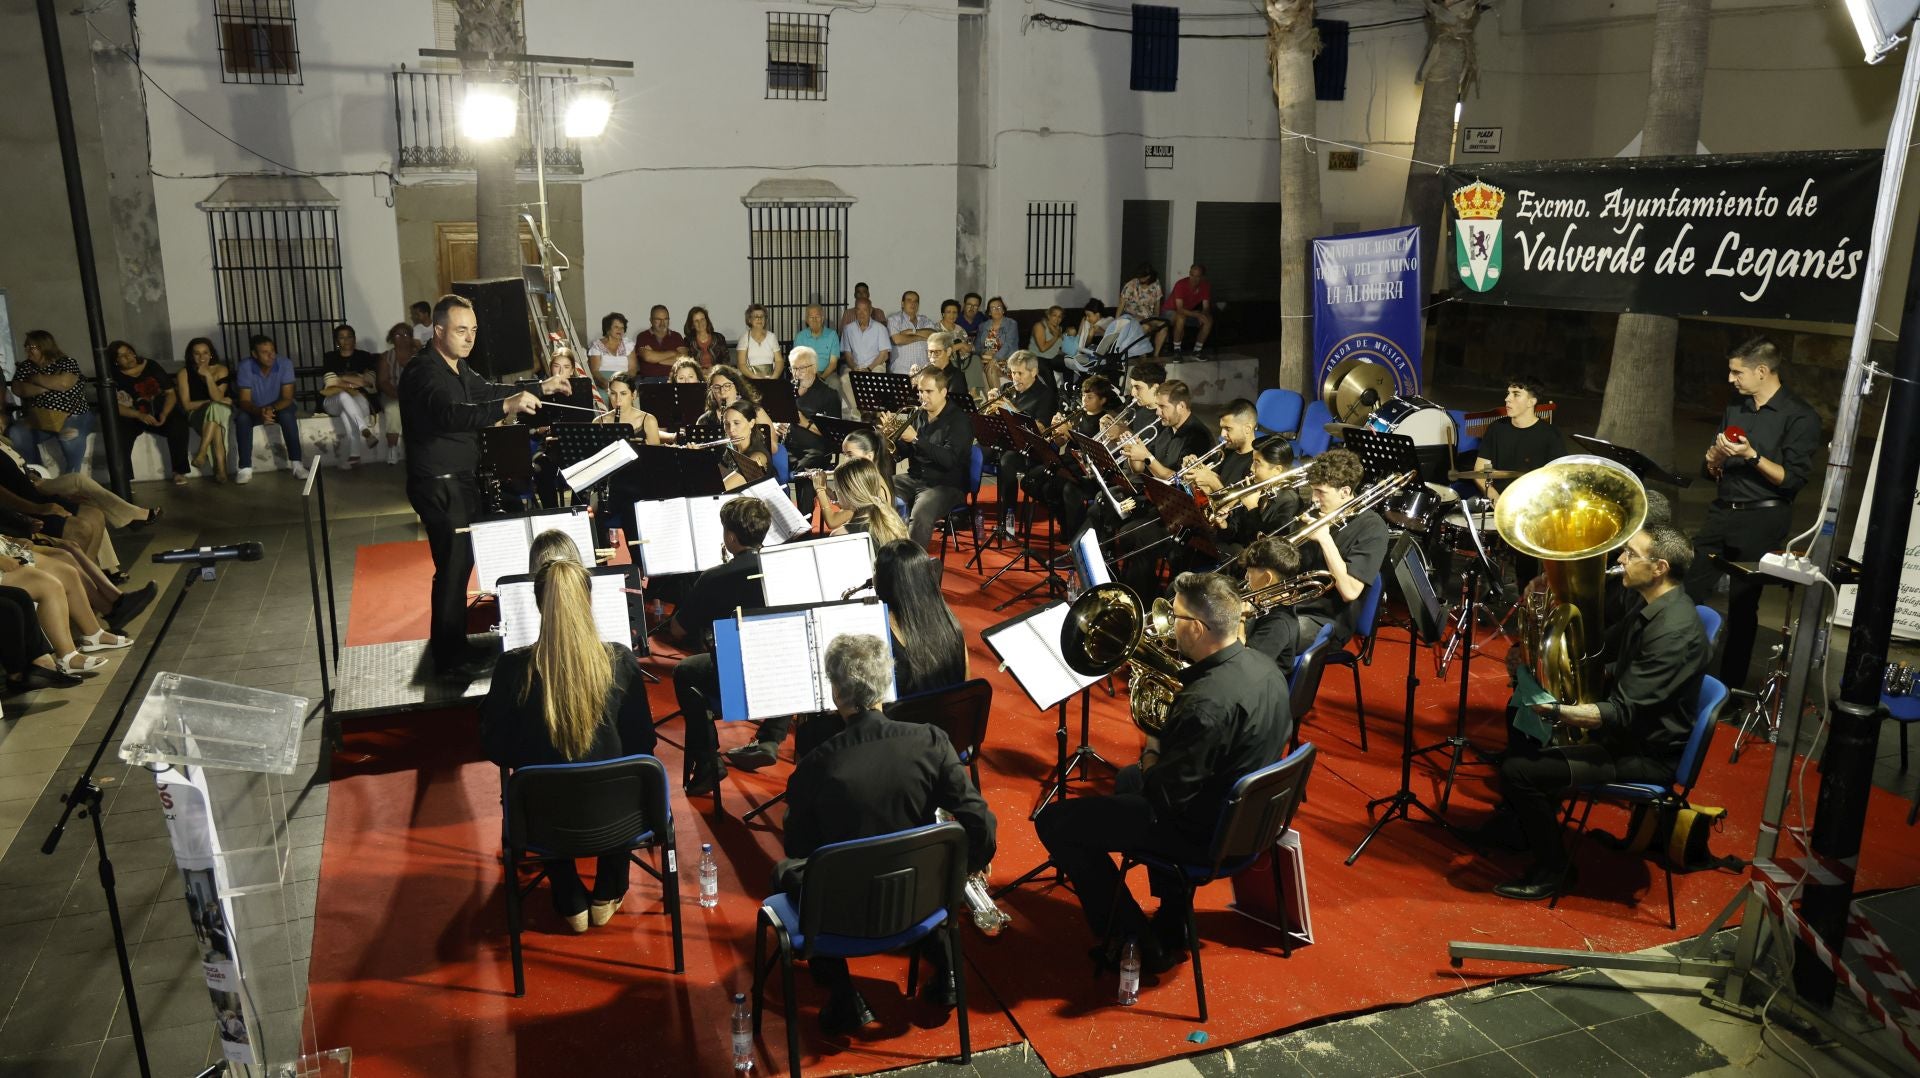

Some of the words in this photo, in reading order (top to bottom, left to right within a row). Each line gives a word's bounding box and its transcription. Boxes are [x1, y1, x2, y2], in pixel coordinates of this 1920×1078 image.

[1515, 188, 1591, 225] Excmo.
[1599, 186, 1779, 235] Ayuntamiento
[1786, 177, 1819, 218] de
[1354, 261, 1372, 277] DEL
[1514, 222, 1646, 274] Valverde
[1653, 222, 1696, 276] de
[1705, 231, 1865, 302] Leganés
[1326, 286, 1341, 305] LA
[1344, 280, 1404, 304] ALBUERA
[1326, 343, 1352, 372] BANDA
[1356, 339, 1368, 348] DE
